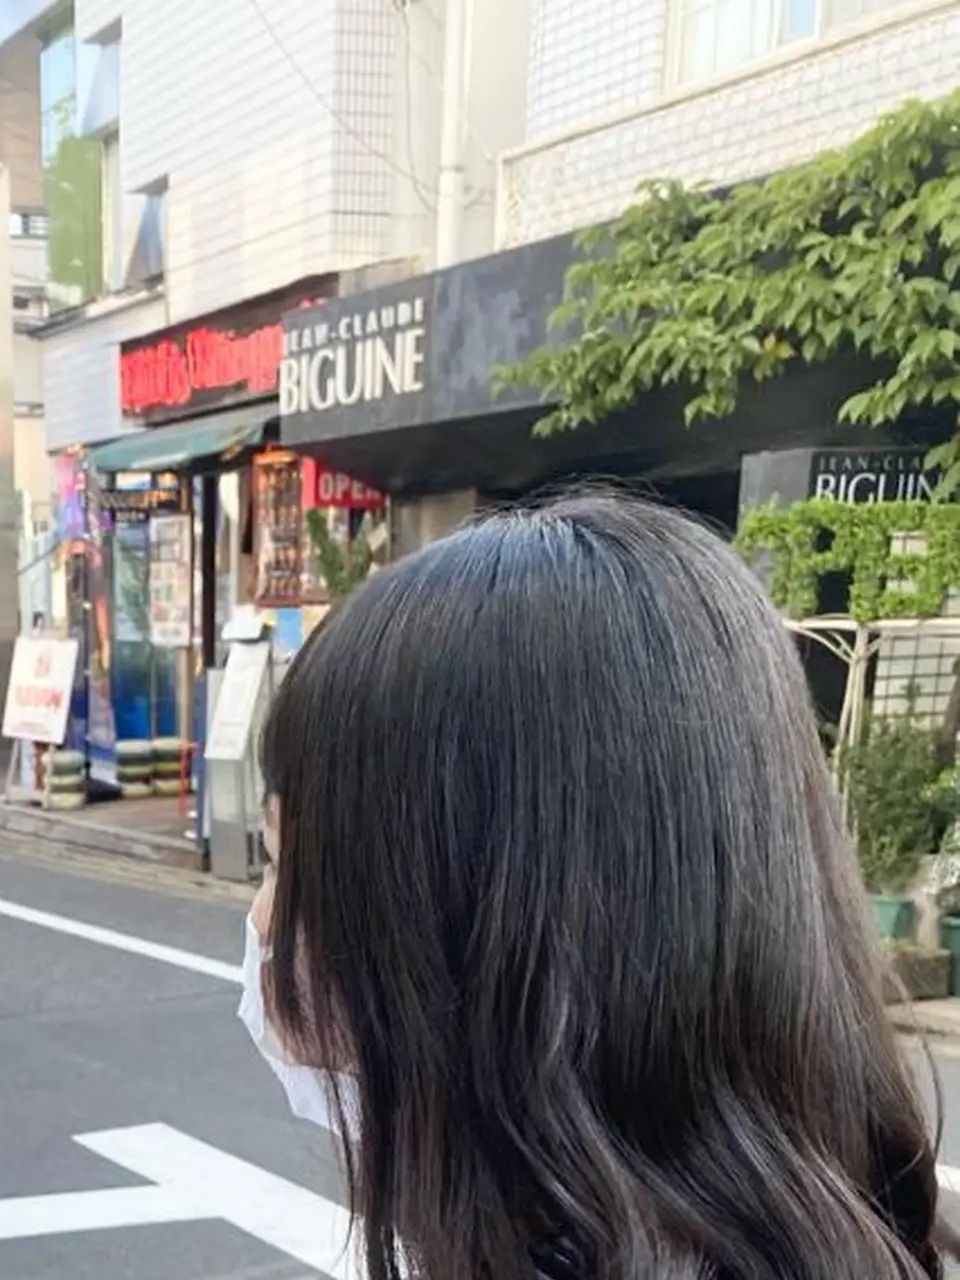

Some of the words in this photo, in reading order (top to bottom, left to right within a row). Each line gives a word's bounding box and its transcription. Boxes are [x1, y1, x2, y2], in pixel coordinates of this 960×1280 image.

[279, 328, 426, 417] BIGUINE
[819, 456, 922, 471] JEAN-CLA
[816, 472, 944, 507] BIGUIN
